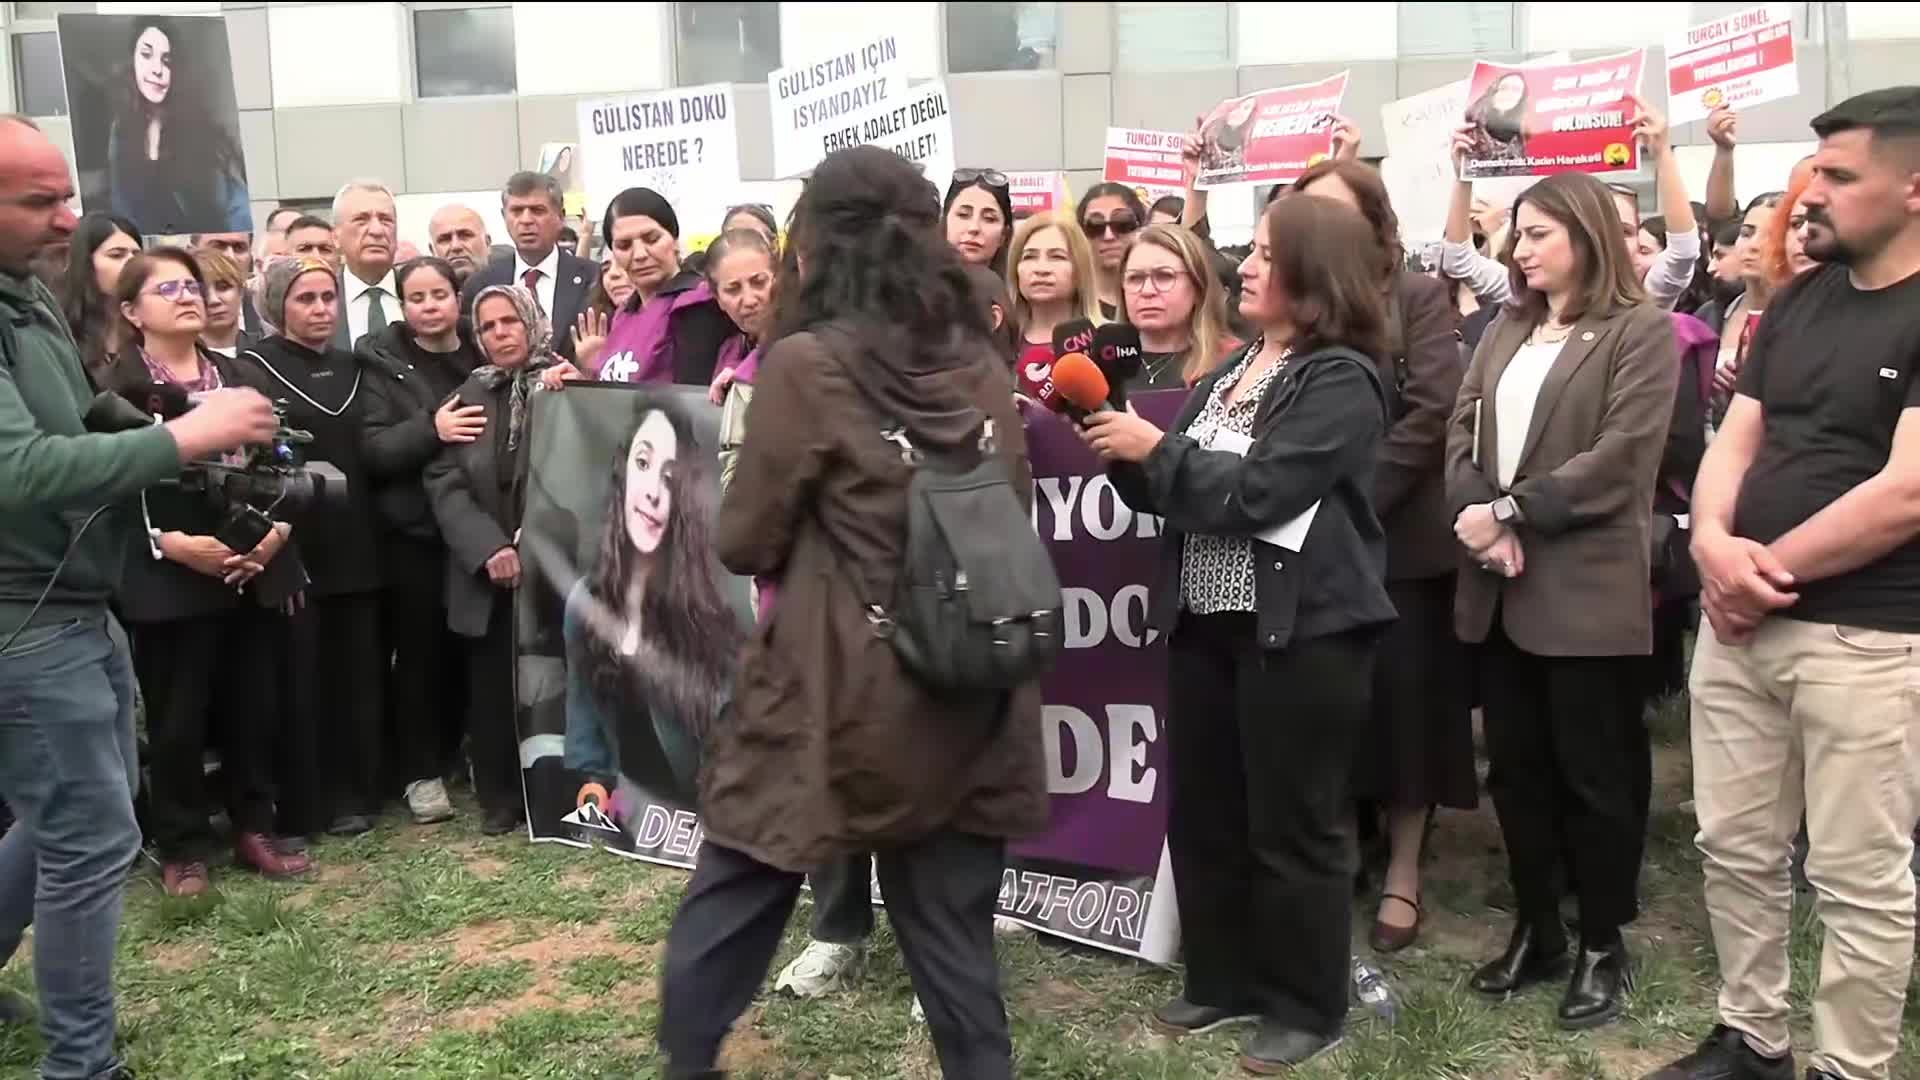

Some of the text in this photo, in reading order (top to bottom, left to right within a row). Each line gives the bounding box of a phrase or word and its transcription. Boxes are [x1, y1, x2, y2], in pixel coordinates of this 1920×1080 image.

[680, 93, 728, 124] DOKU
[864, 107, 907, 142] ADALET
[622, 137, 704, 171] NEREDE ?
[1063, 328, 1094, 352] CNN
